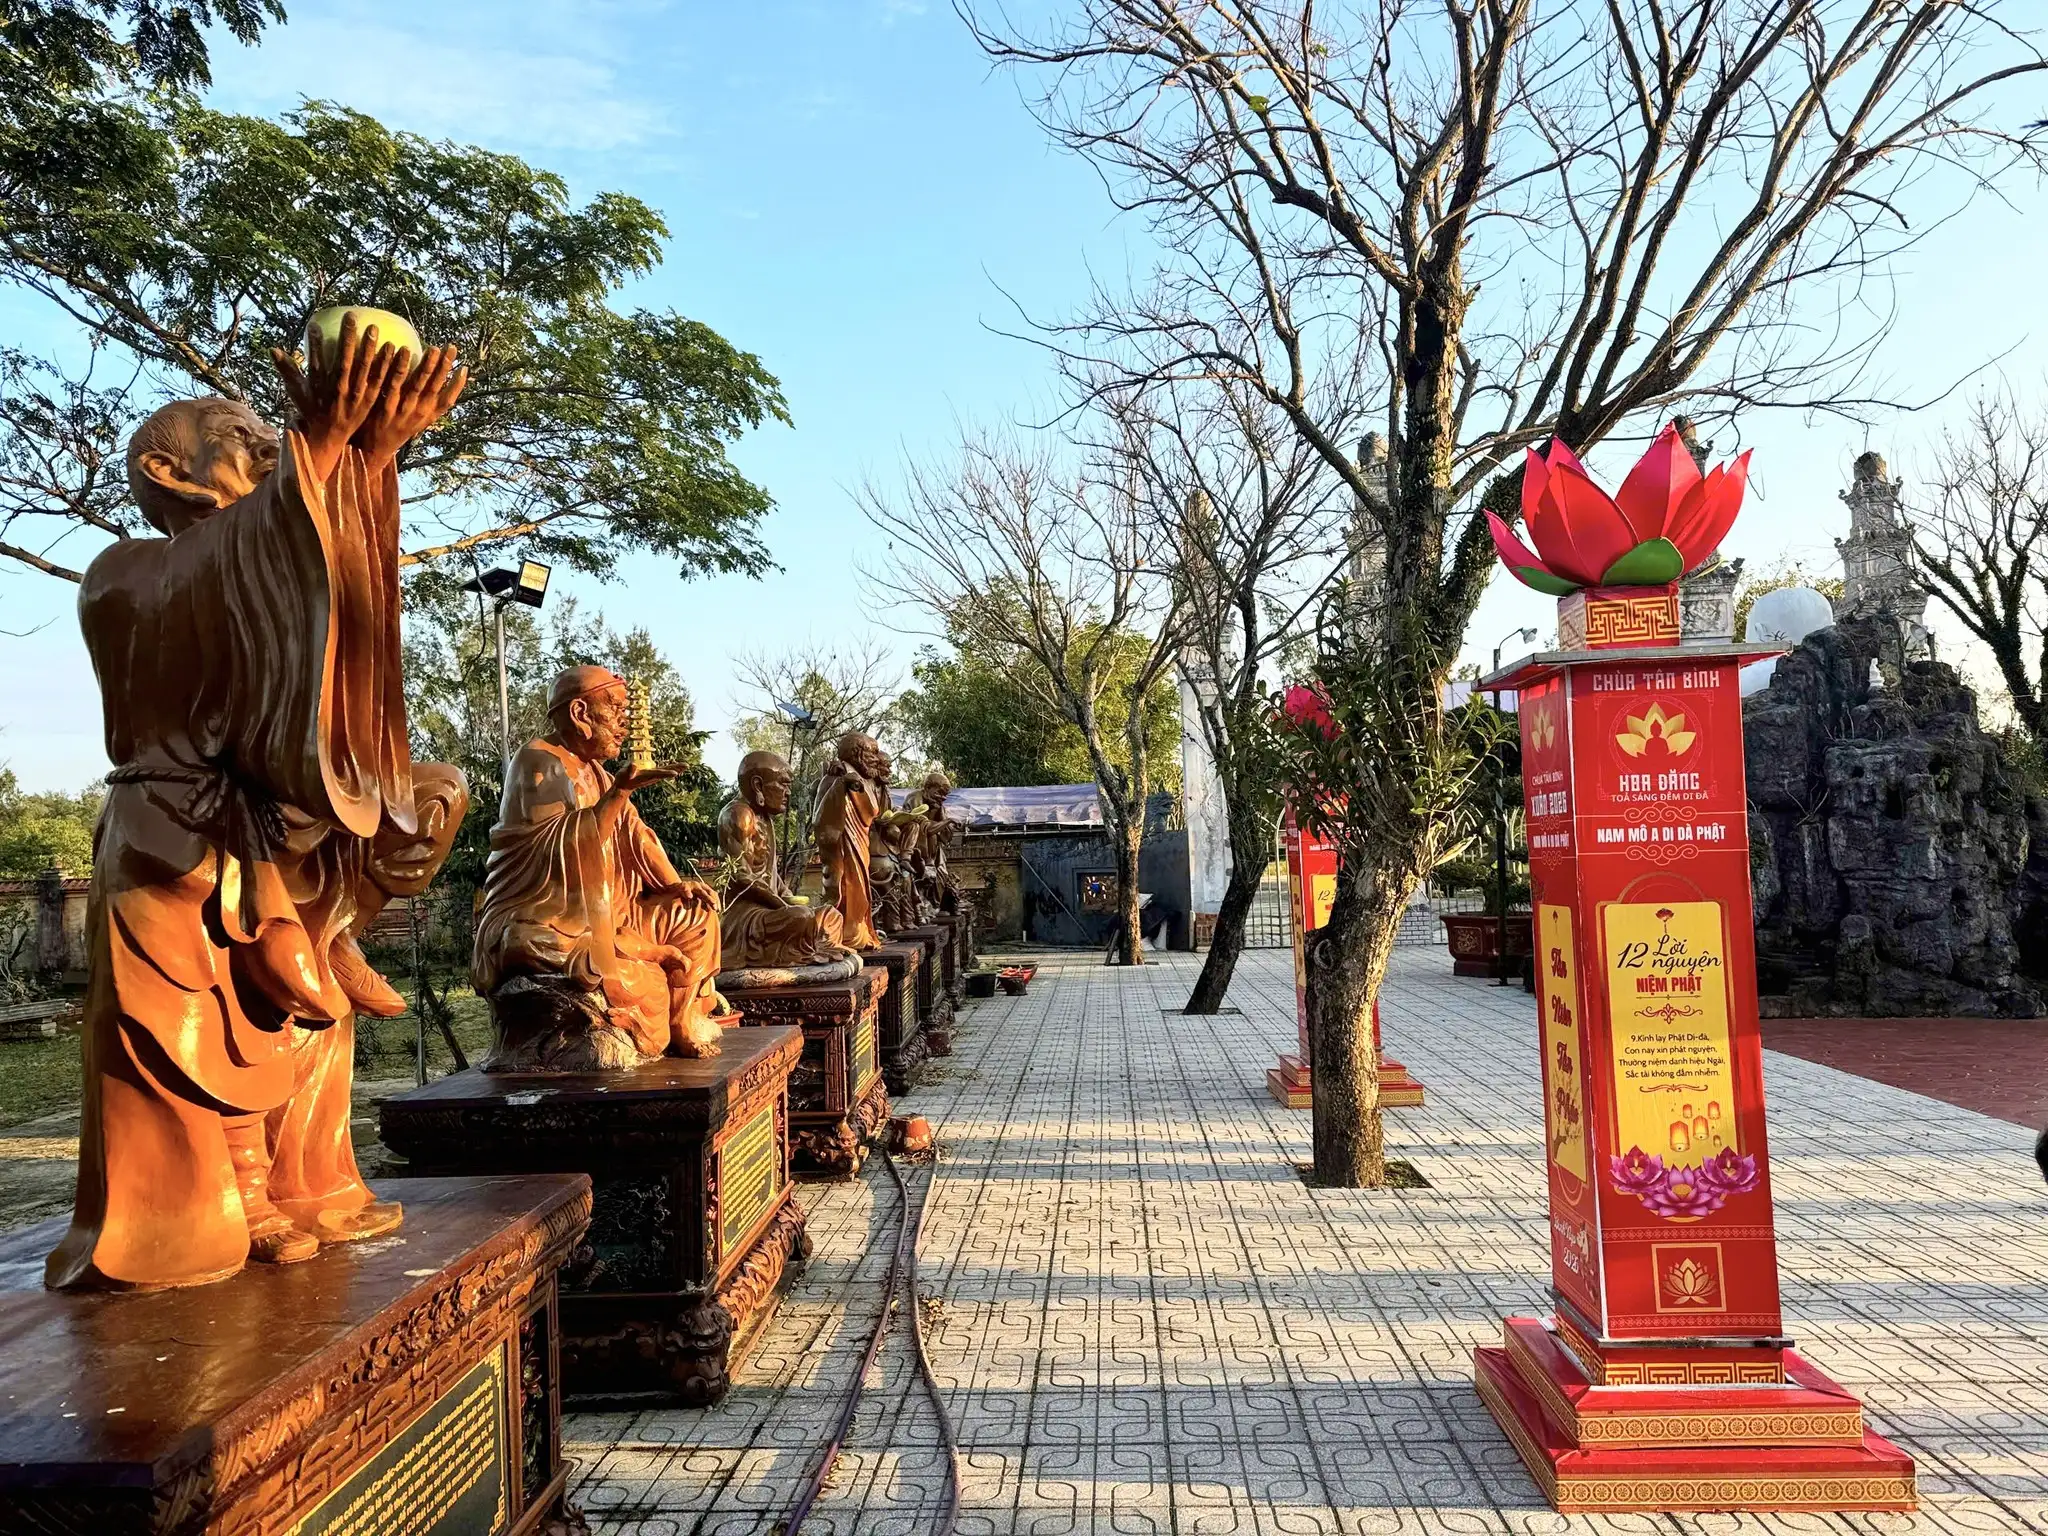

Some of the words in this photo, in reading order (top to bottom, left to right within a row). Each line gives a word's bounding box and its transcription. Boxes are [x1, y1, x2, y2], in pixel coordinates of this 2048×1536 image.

[1593, 669, 1635, 691] CHÙA
[1642, 668, 1676, 690] TÂN
[1682, 667, 1720, 689] BÌNH
[1619, 774, 1651, 792] HOA
[1658, 768, 1700, 791] ĐĂNG
[1632, 791, 1657, 802] SÁNG
[1597, 828, 1624, 843] NAM
[1628, 824, 1648, 842] MÔ
[1651, 827, 1659, 842] A
[1662, 826, 1674, 841] DI
[1696, 822, 1726, 843] PHẬT
[1317, 889, 1331, 901] 12
[1617, 942, 1649, 969] 12
[1652, 933, 1688, 957] Lời
[1651, 950, 1722, 975] nguyện
[1636, 974, 1668, 996] NIỆM
[1671, 972, 1702, 995] PHẬT
[1668, 1033, 1685, 1042] Phật
[1624, 1047, 1640, 1055] Con
[1656, 1046, 1668, 1054] xin
[1669, 1045, 1687, 1055] phát
[1648, 1058, 1668, 1066] niệm
[1668, 1057, 1688, 1065] danh
[1689, 1057, 1706, 1065] hiệu
[1651, 1069, 1675, 1079] không
